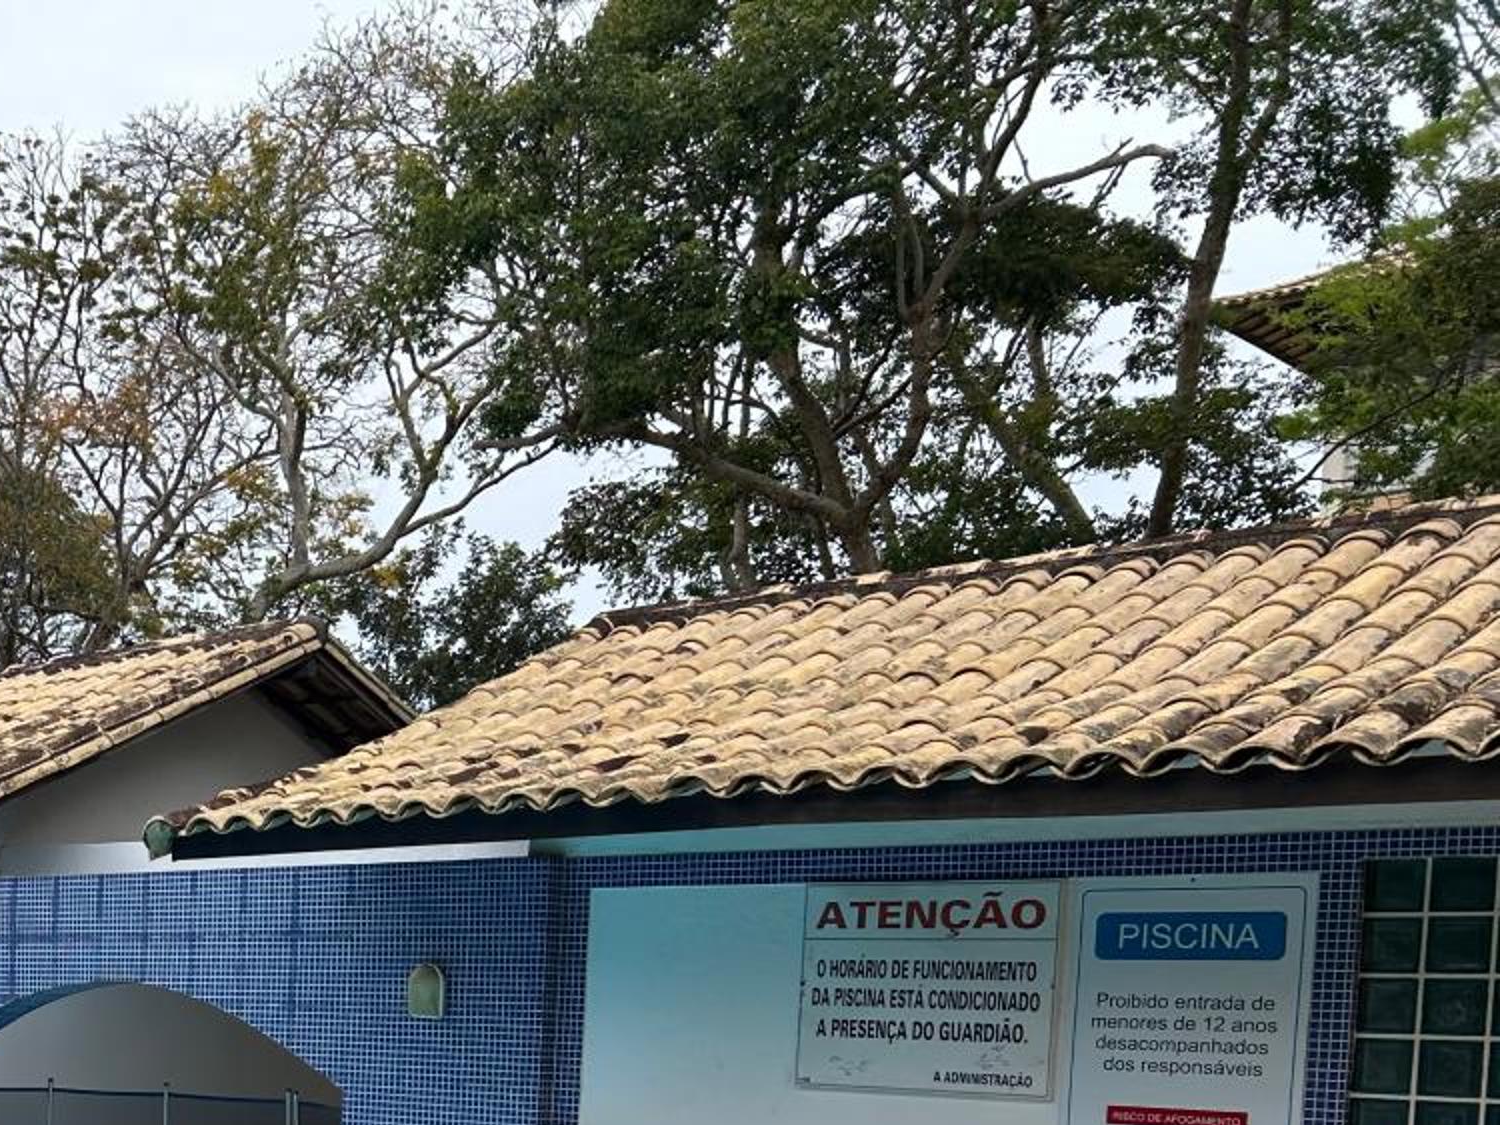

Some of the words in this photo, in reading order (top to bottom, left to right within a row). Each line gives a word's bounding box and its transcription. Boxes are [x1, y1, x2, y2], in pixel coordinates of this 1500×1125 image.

[816, 891, 1046, 936] ATENÇÃO
[1118, 923, 1259, 949] PISCINA
[817, 960, 826, 978] O
[830, 953, 887, 978] HORÁRIO
[891, 961, 909, 979] DE
[913, 961, 1037, 981] FUNCIONAMENTO
[812, 987, 830, 1006] DA
[835, 988, 885, 1008] PISCINA
[890, 984, 923, 1009] ESTÁ
[929, 991, 1040, 1012] CONDICIONADO
[1097, 992, 1168, 1009] Proibido
[1175, 995, 1245, 1011] entrada
[1252, 996, 1275, 1011] de
[816, 1019, 826, 1037] A
[831, 1020, 907, 1043] PRESENÇA
[912, 1022, 934, 1041] DO
[940, 1018, 1028, 1044] GUARDIÃO.
[1091, 1017, 1167, 1030] menores
[1173, 1017, 1196, 1031] de
[1206, 1018, 1225, 1032] 12
[1231, 1021, 1278, 1033] anos
[1095, 1036, 1268, 1055] desacompanhados
[1103, 1057, 1134, 1071] dos
[1141, 1060, 1263, 1077] responsáveis
[933, 1071, 940, 1083] A
[944, 1071, 1032, 1088] ADMINISTRAÇÃO
[1147, 1113, 1161, 1122] DE
